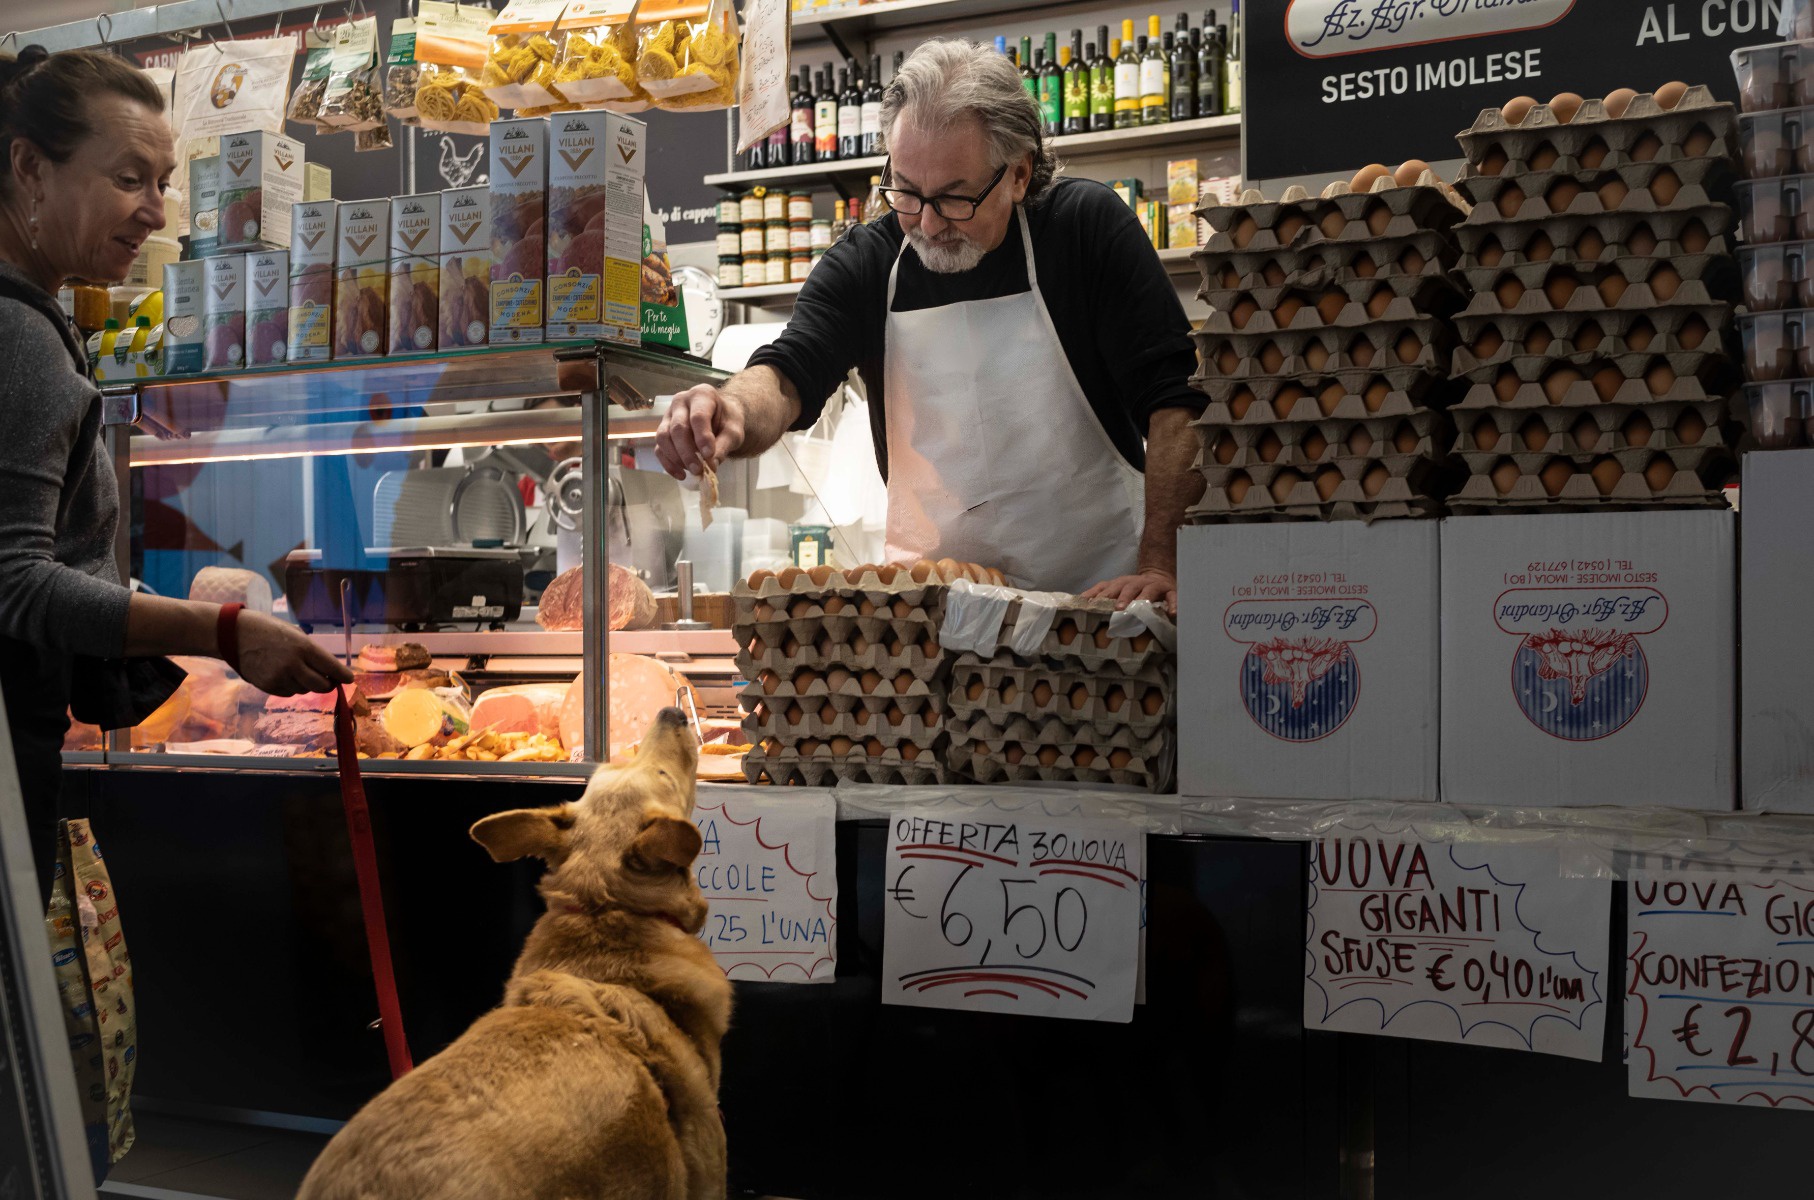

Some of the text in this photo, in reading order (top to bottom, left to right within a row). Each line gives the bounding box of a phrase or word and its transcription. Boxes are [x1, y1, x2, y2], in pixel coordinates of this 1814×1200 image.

[1635, 3, 1691, 47] AL
[1321, 48, 1542, 104] SESTO IMOLESE
[559, 137, 595, 147] VILLANI
[617, 136, 637, 148] VILLANI
[226, 149, 253, 159] VILLANI
[499, 144, 535, 154] VILLANI
[449, 211, 482, 222] VILLANI
[670, 206, 682, 221] di
[298, 221, 326, 230] VILLANI
[398, 217, 430, 228] VILLANI
[346, 224, 378, 234] VILLANI
[254, 269, 280, 277] VILLANI
[657, 323, 681, 341] meglio
[1527, 561, 1567, 572] 677129
[1253, 573, 1289, 584] 677129
[1535, 573, 1568, 584] IMOLA
[1577, 573, 1621, 583] IMOLESE
[1624, 572, 1658, 583] SESTO
[1259, 585, 1289, 596] IMOLA
[1297, 585, 1336, 595] IMOLESE
[1338, 584, 1368, 594] SESTO
[1499, 602, 1579, 624] Orlandini
[1228, 611, 1299, 631] Orlandini
[896, 817, 1019, 855] OFFERTA
[1318, 838, 1435, 891] UOVA
[1635, 880, 1747, 916] UOVA
[1359, 886, 1500, 934] GIGANTI
[761, 911, 827, 944] L'UNA
[1320, 930, 1418, 978] SFUSE
